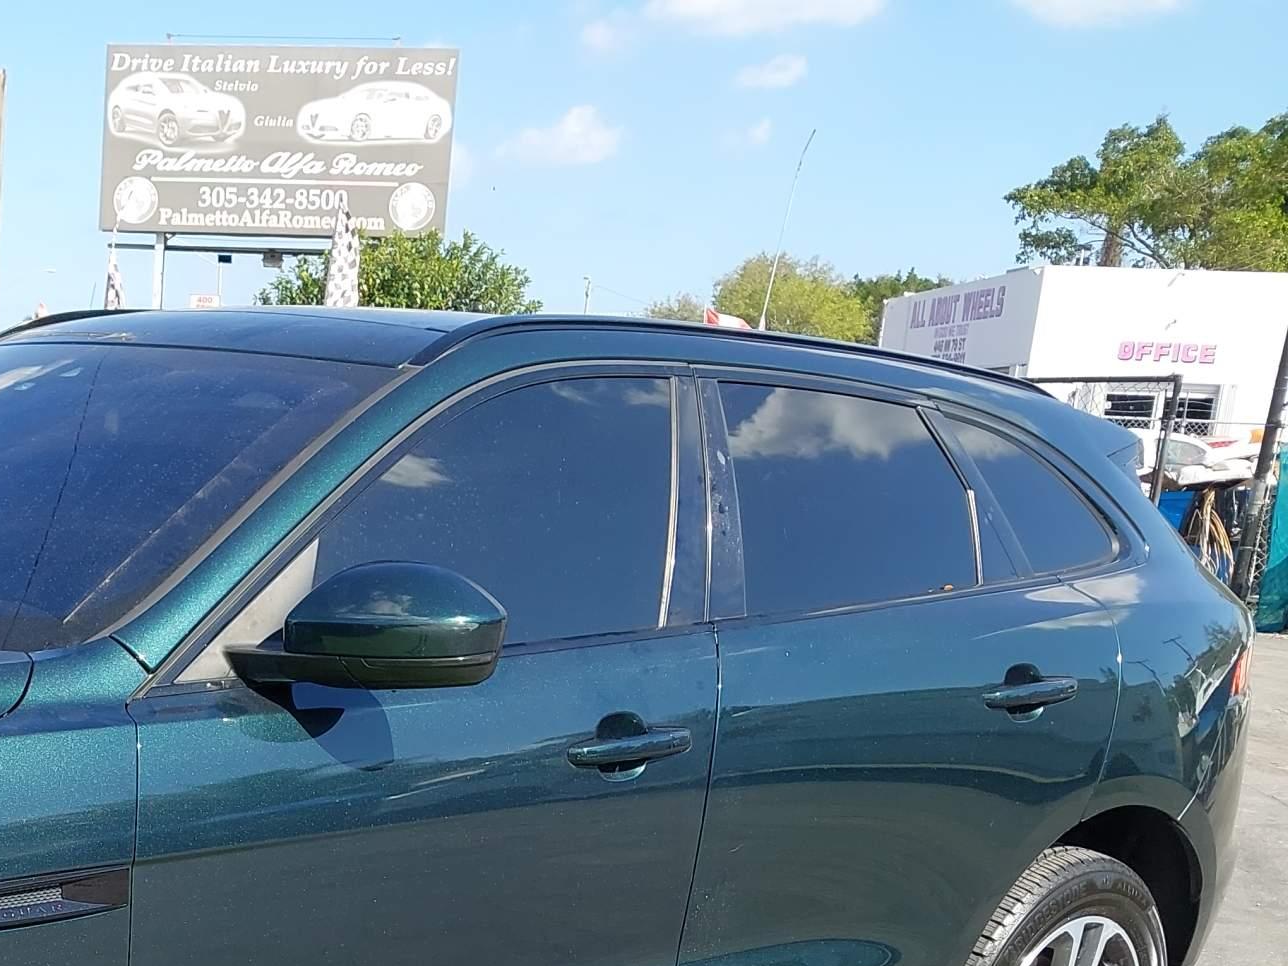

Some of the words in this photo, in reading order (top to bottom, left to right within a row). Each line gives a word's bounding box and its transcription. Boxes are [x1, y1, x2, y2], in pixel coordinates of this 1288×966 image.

[111, 53, 175, 72] Drive
[180, 54, 260, 73] Italian
[267, 55, 349, 80] Luxury
[351, 56, 390, 80] for
[395, 57, 456, 76] Less!
[214, 80, 259, 92] Stelvio
[254, 115, 294, 127] Giulia
[132, 149, 259, 172] Palmetto
[261, 152, 326, 178] Alfa
[329, 153, 424, 176] Romeo
[198, 186, 348, 210] 305-342-8500
[158, 208, 385, 230] PalmettoAlfaRomecom
[910, 300, 926, 328] ALL
[928, 295, 960, 326] ABOUT
[962, 286, 1006, 322] WHEELS
[1117, 341, 1217, 364] OFFICE
